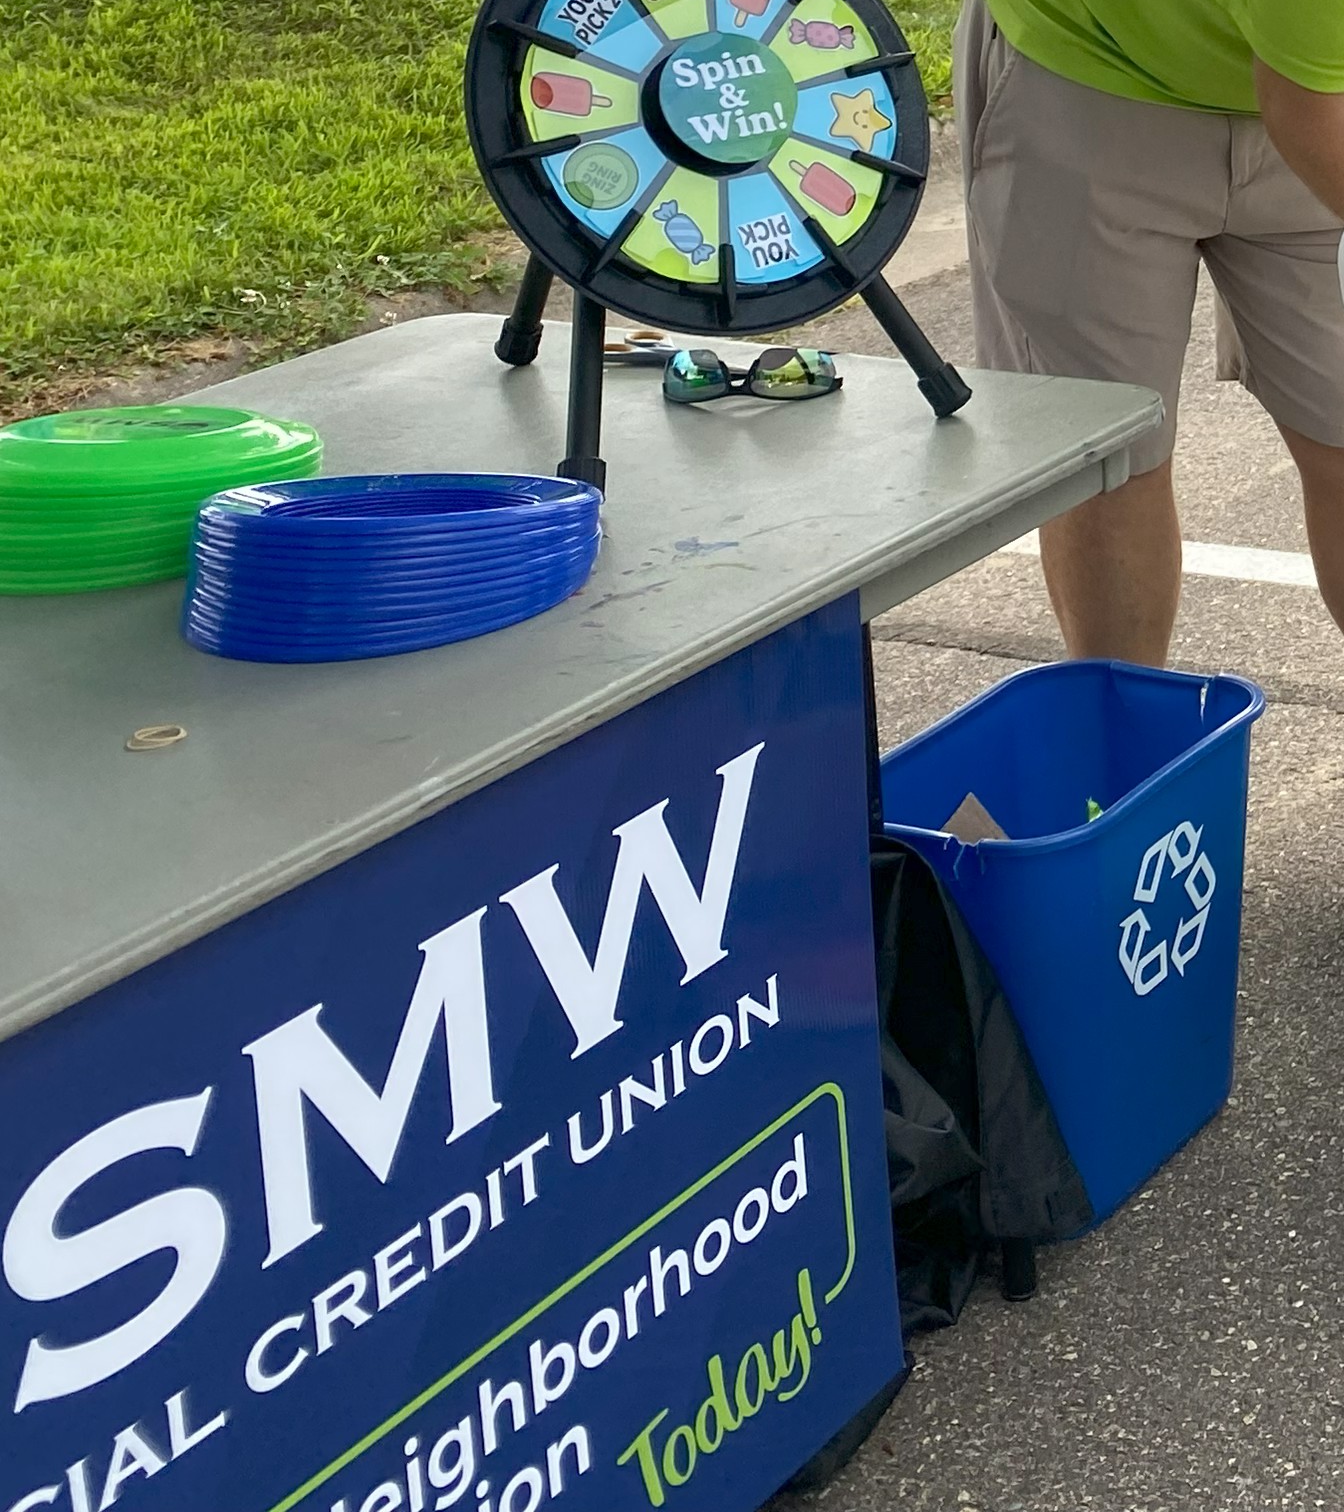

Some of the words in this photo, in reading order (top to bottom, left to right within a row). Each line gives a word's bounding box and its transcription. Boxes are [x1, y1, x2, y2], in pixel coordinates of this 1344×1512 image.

[575, 1, 614, 45] PICK
[672, 51, 766, 90] Spin
[719, 83, 750, 109] &
[686, 102, 787, 144] Win!
[738, 214, 791, 246] PICK
[752, 238, 800, 268] YOU
[3, 741, 765, 1413] SMW
[245, 1134, 551, 1393] CREDIT
[566, 974, 782, 1165] UNION
[330, 1134, 809, 1512] eighborhood
[618, 1268, 823, 1509] Today!
